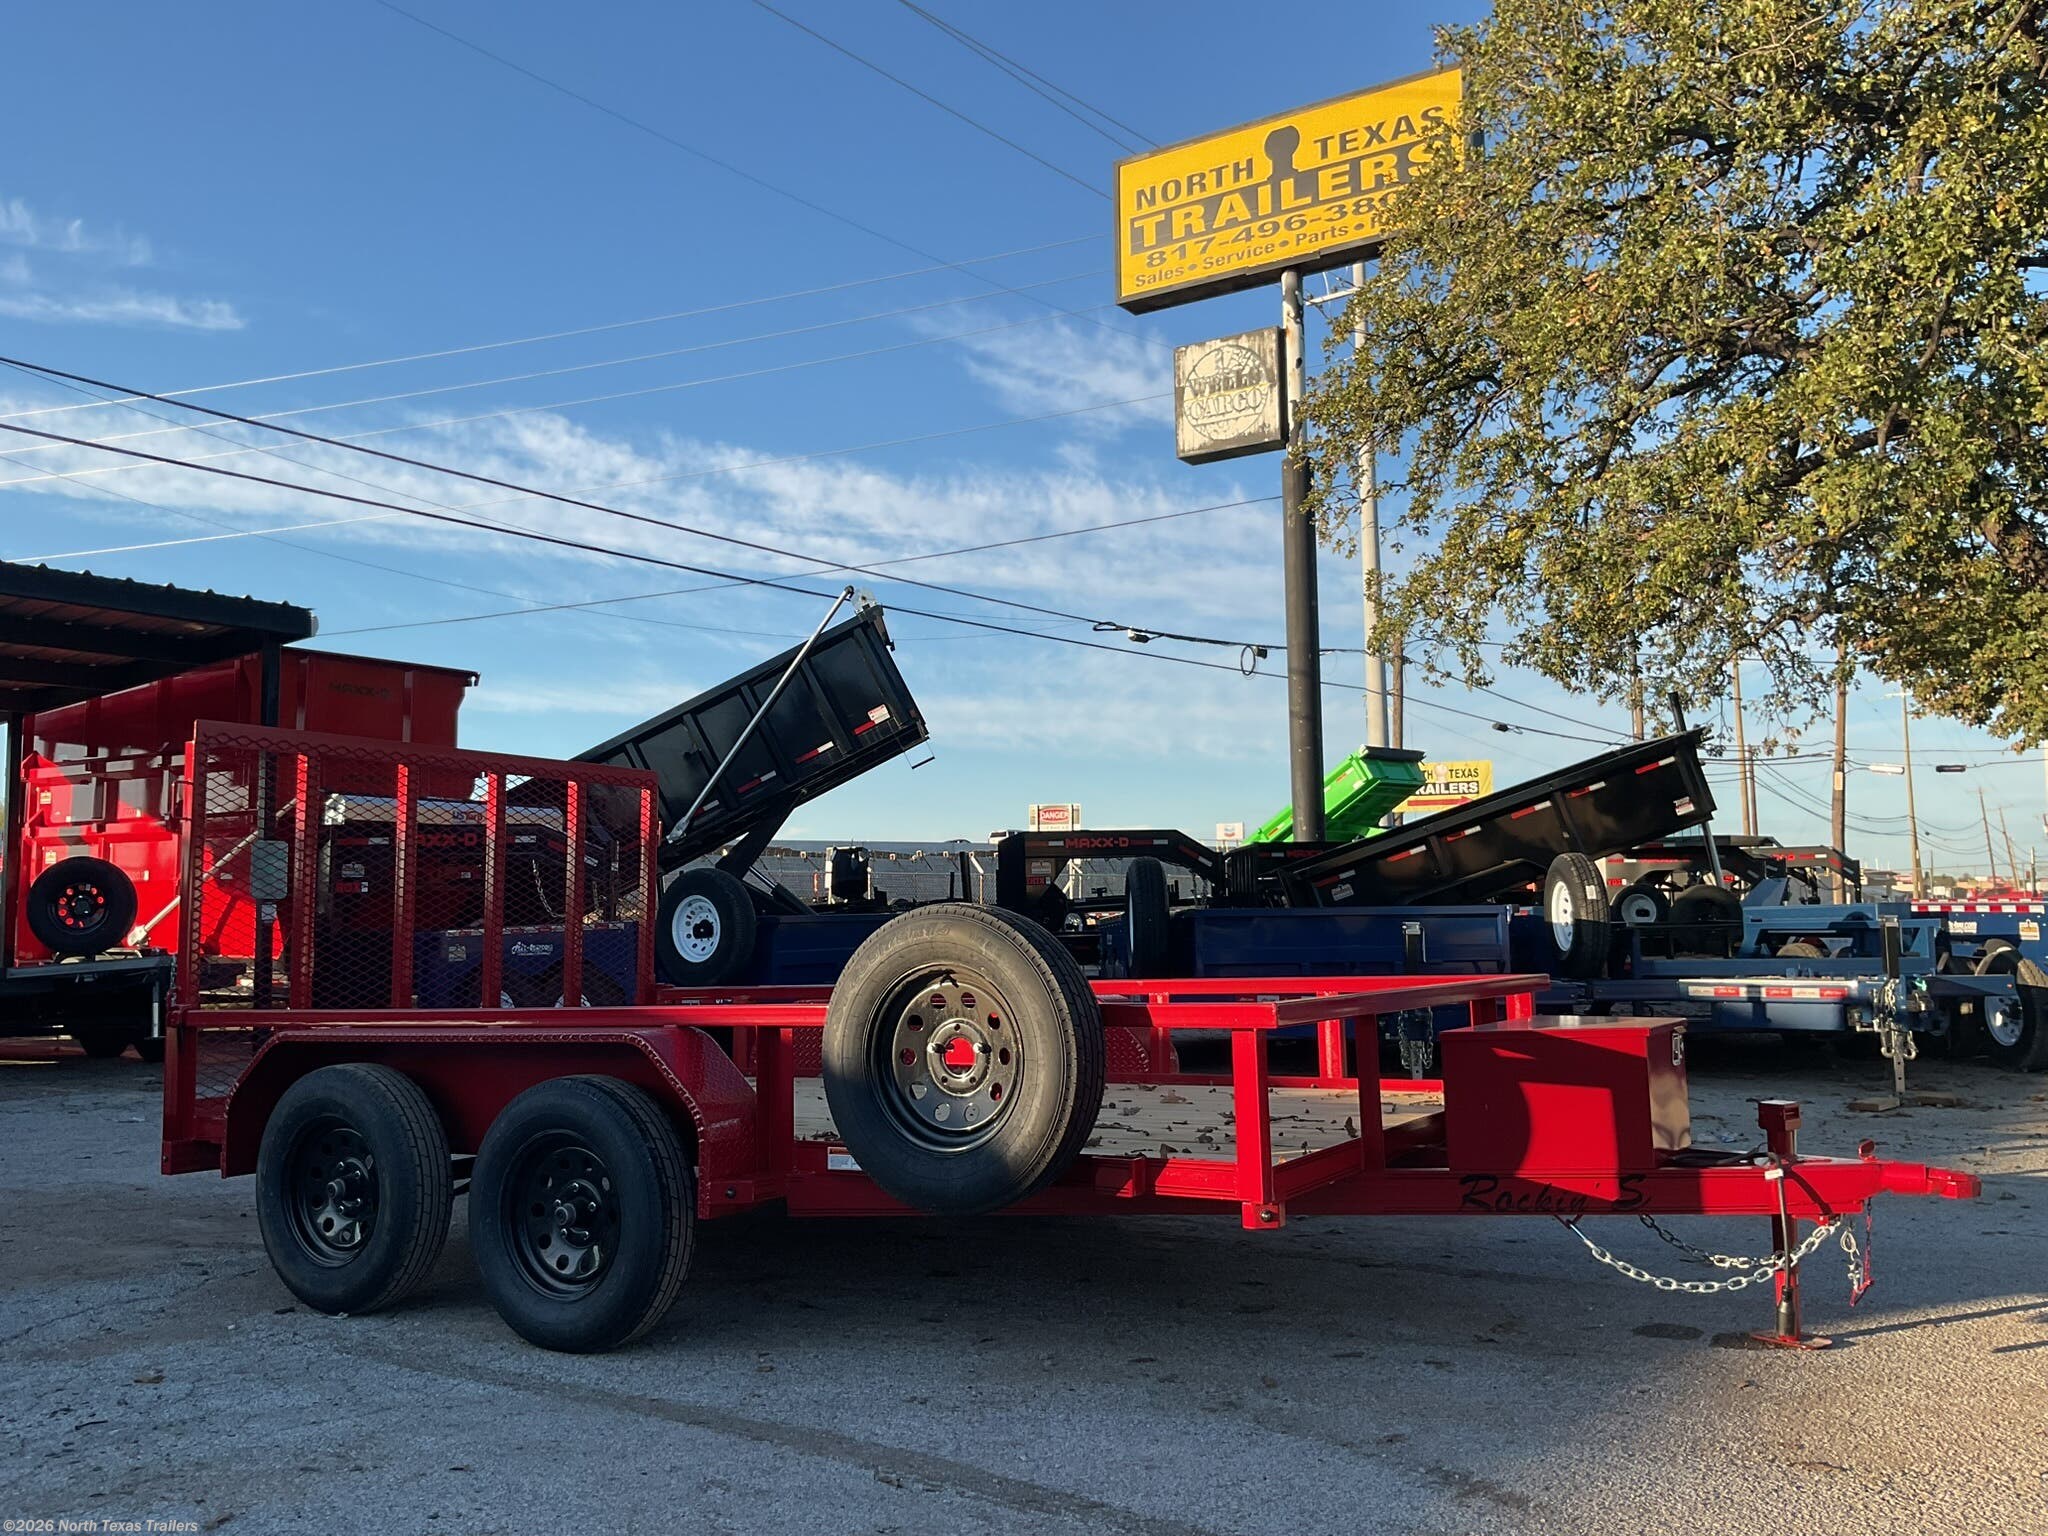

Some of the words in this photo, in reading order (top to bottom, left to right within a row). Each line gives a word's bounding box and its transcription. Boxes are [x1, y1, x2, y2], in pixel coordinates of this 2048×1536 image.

[1136, 158, 1254, 211] NORTH
[1313, 106, 1445, 160] TEXAS
[1135, 266, 1185, 287] Sales
[1203, 242, 1275, 270] Service
[1296, 225, 1349, 247] Parts
[1190, 387, 1263, 420] CARGO
[1449, 768, 1479, 779] TEXAS
[1415, 782, 1478, 795] RAILERS
[1040, 810, 1070, 820] DANGER
[1065, 837, 1129, 849] MAXX-D
